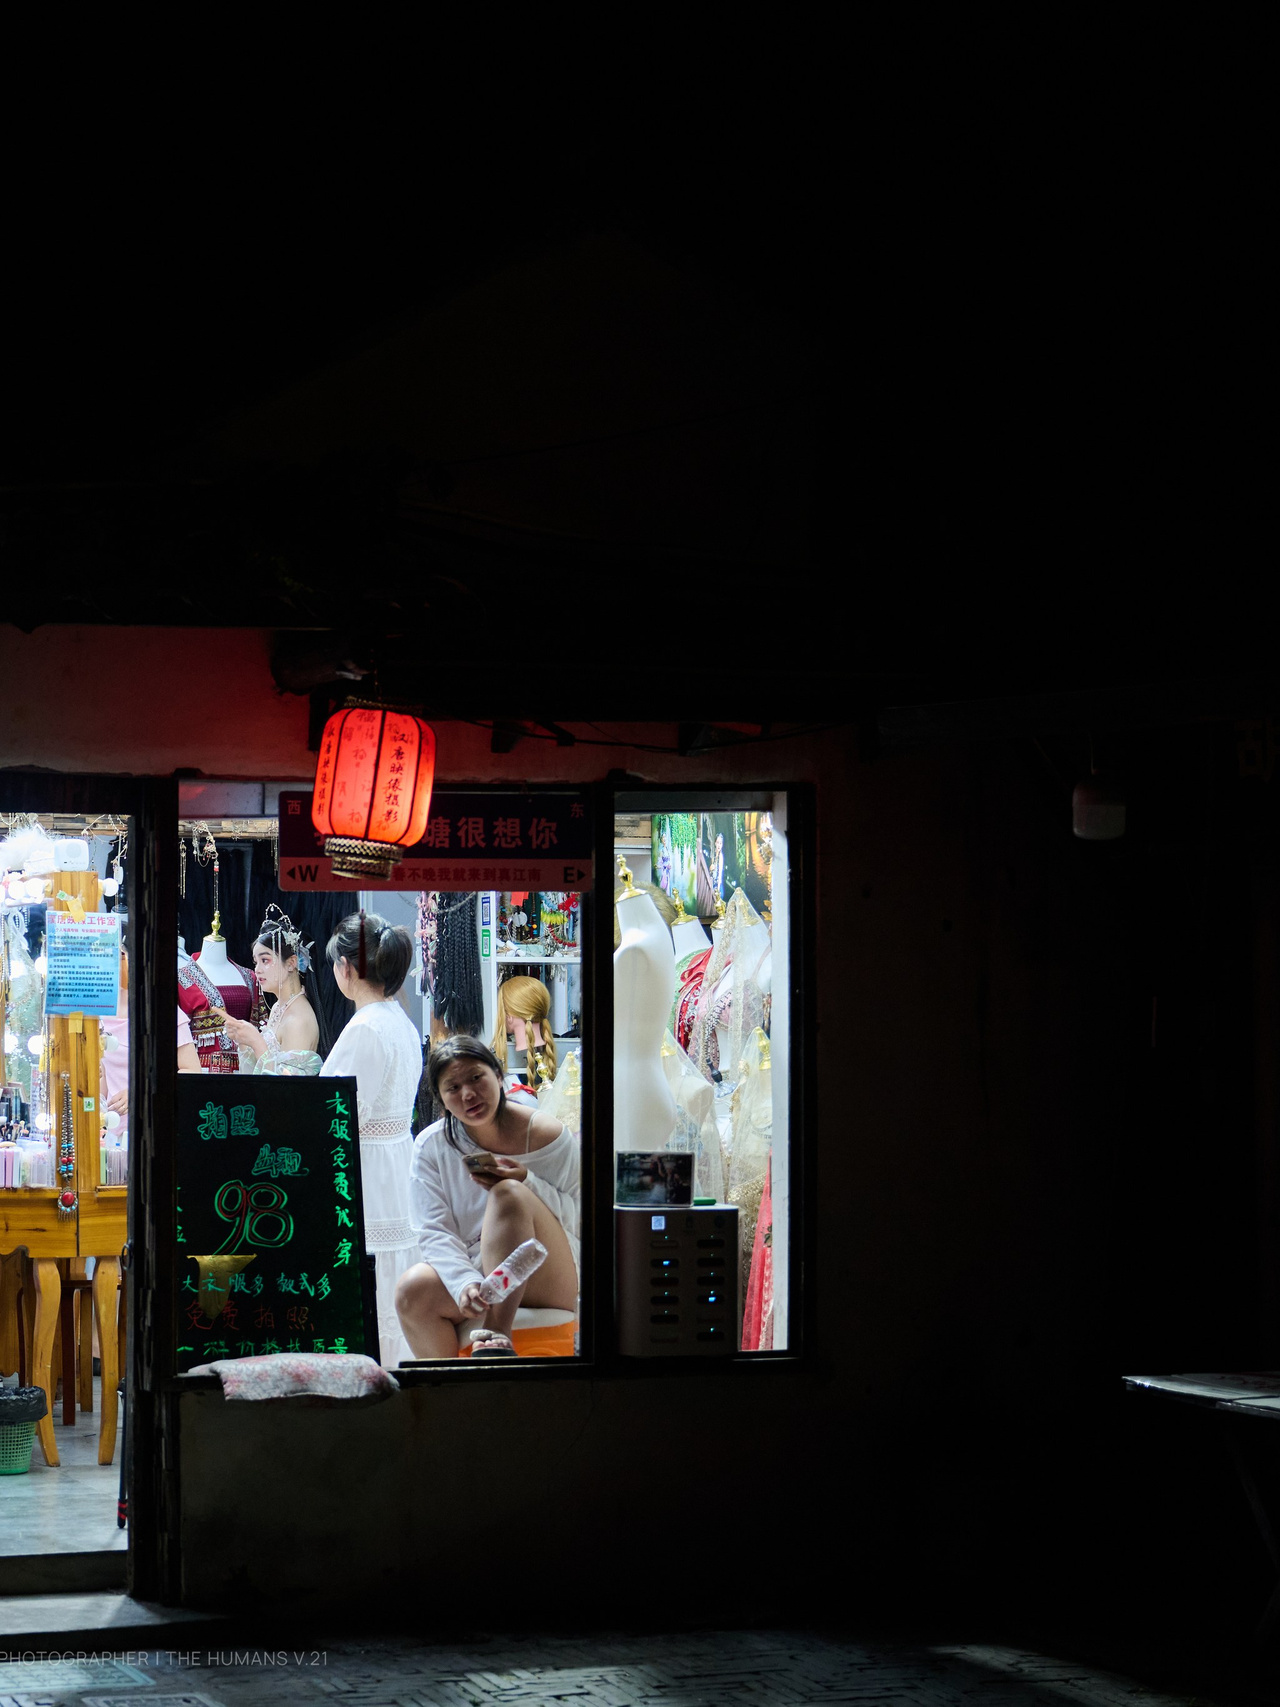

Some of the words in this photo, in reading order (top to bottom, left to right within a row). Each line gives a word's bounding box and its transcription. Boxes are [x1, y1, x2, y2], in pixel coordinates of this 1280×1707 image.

[286, 800, 301, 815] 西
[569, 802, 584, 819] 东
[298, 865, 319, 882] W
[563, 866, 575, 883] E
[214, 1179, 295, 1256] 98
